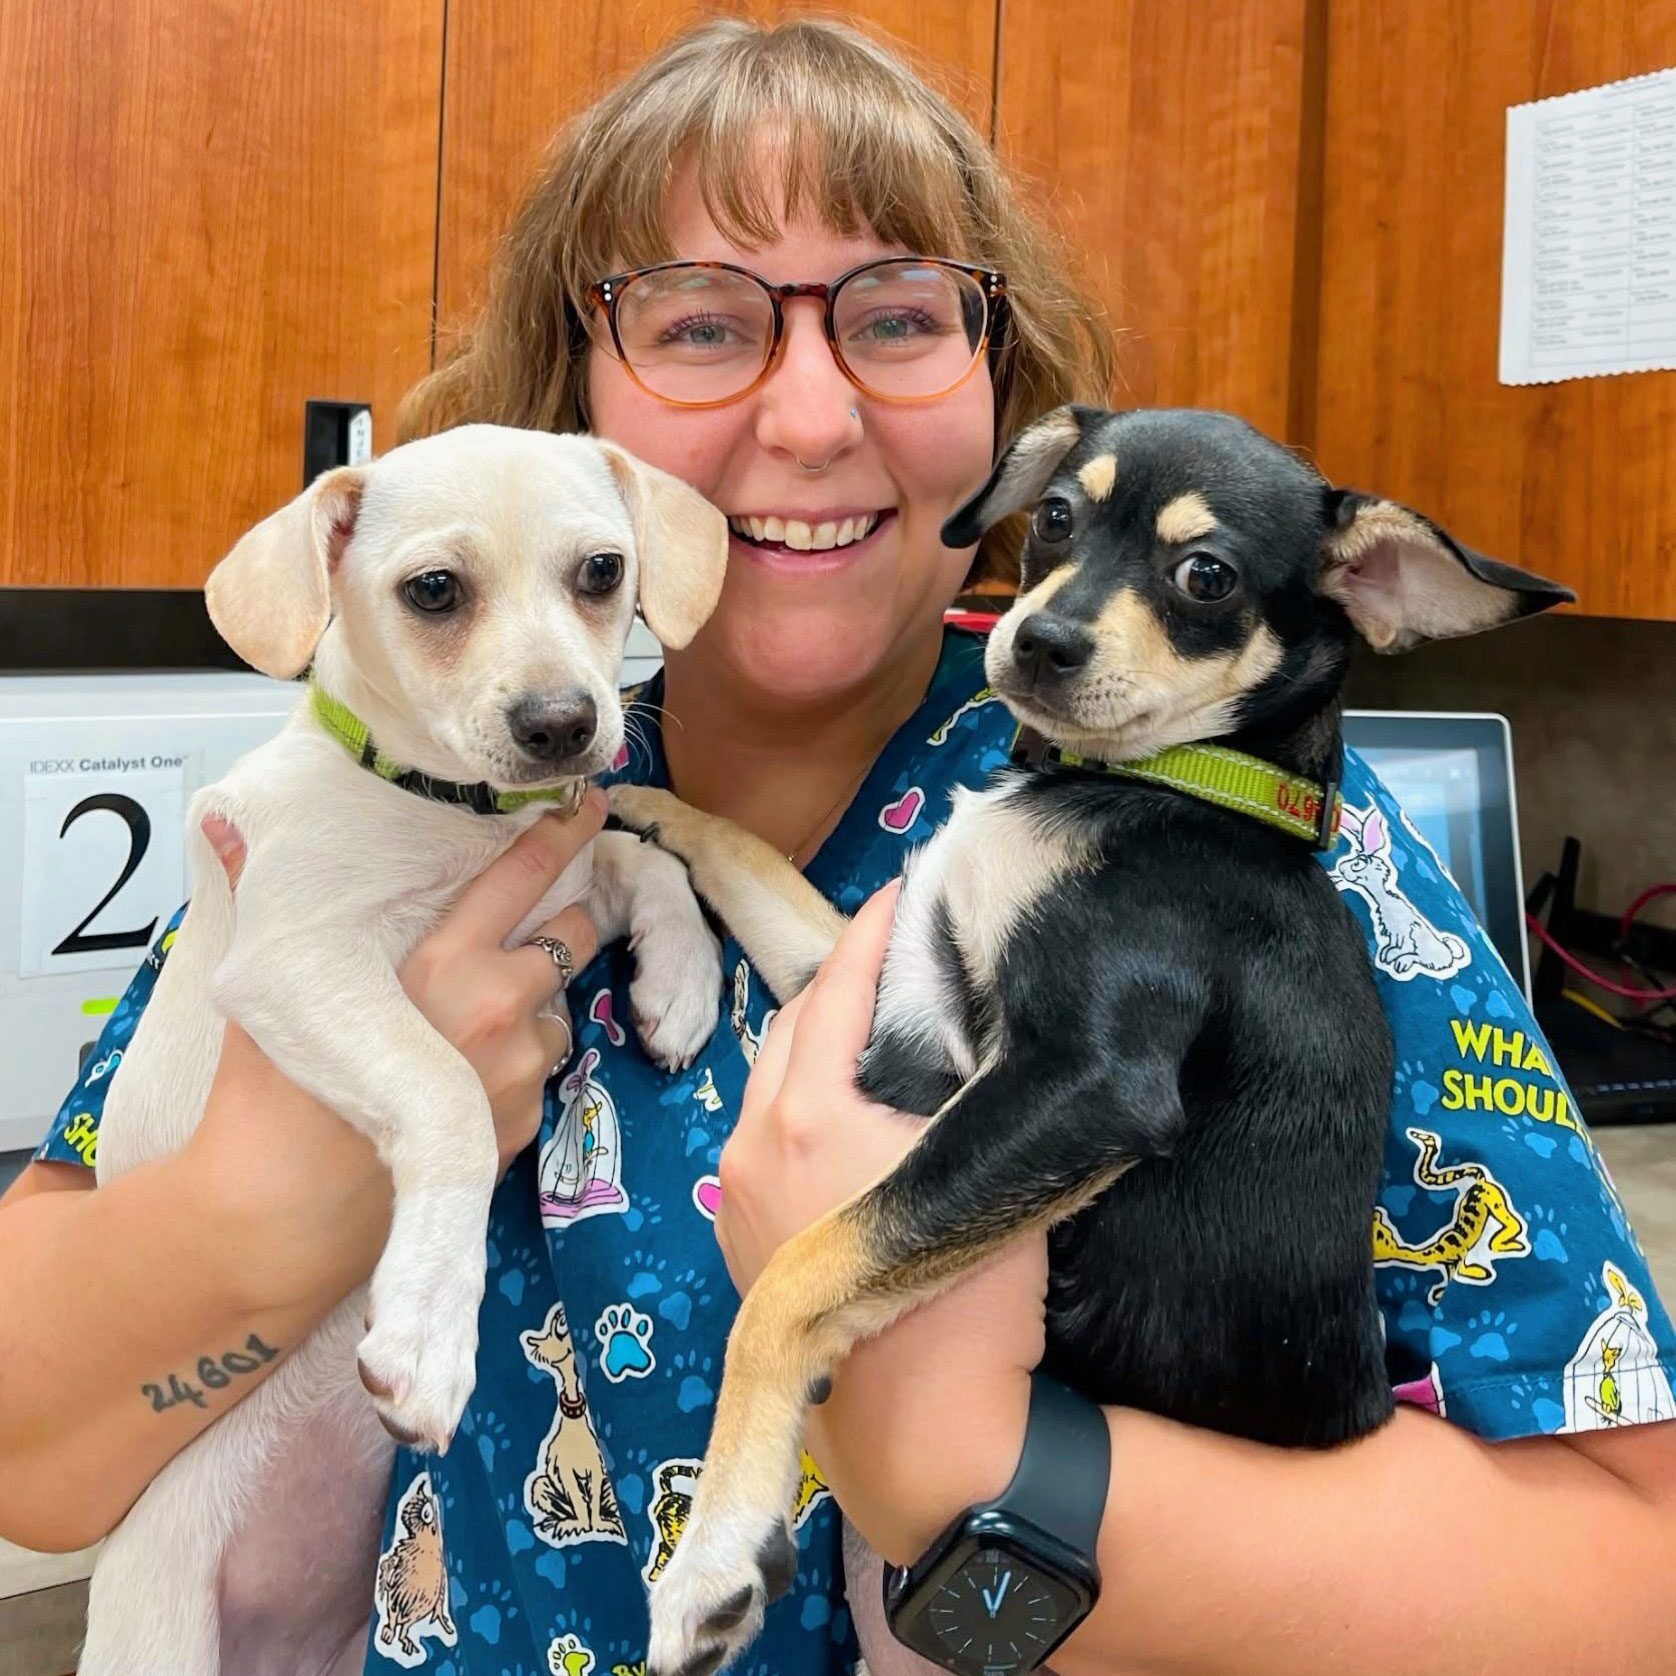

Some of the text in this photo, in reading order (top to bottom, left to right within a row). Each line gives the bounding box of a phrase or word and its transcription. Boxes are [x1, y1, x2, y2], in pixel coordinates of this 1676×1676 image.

[30, 760, 75, 774] IDEXX
[79, 758, 146, 772] Catalyst
[51, 793, 160, 955] 2
[1441, 1069, 1582, 1138] SHOUL
[141, 1333, 279, 1413] 24601
